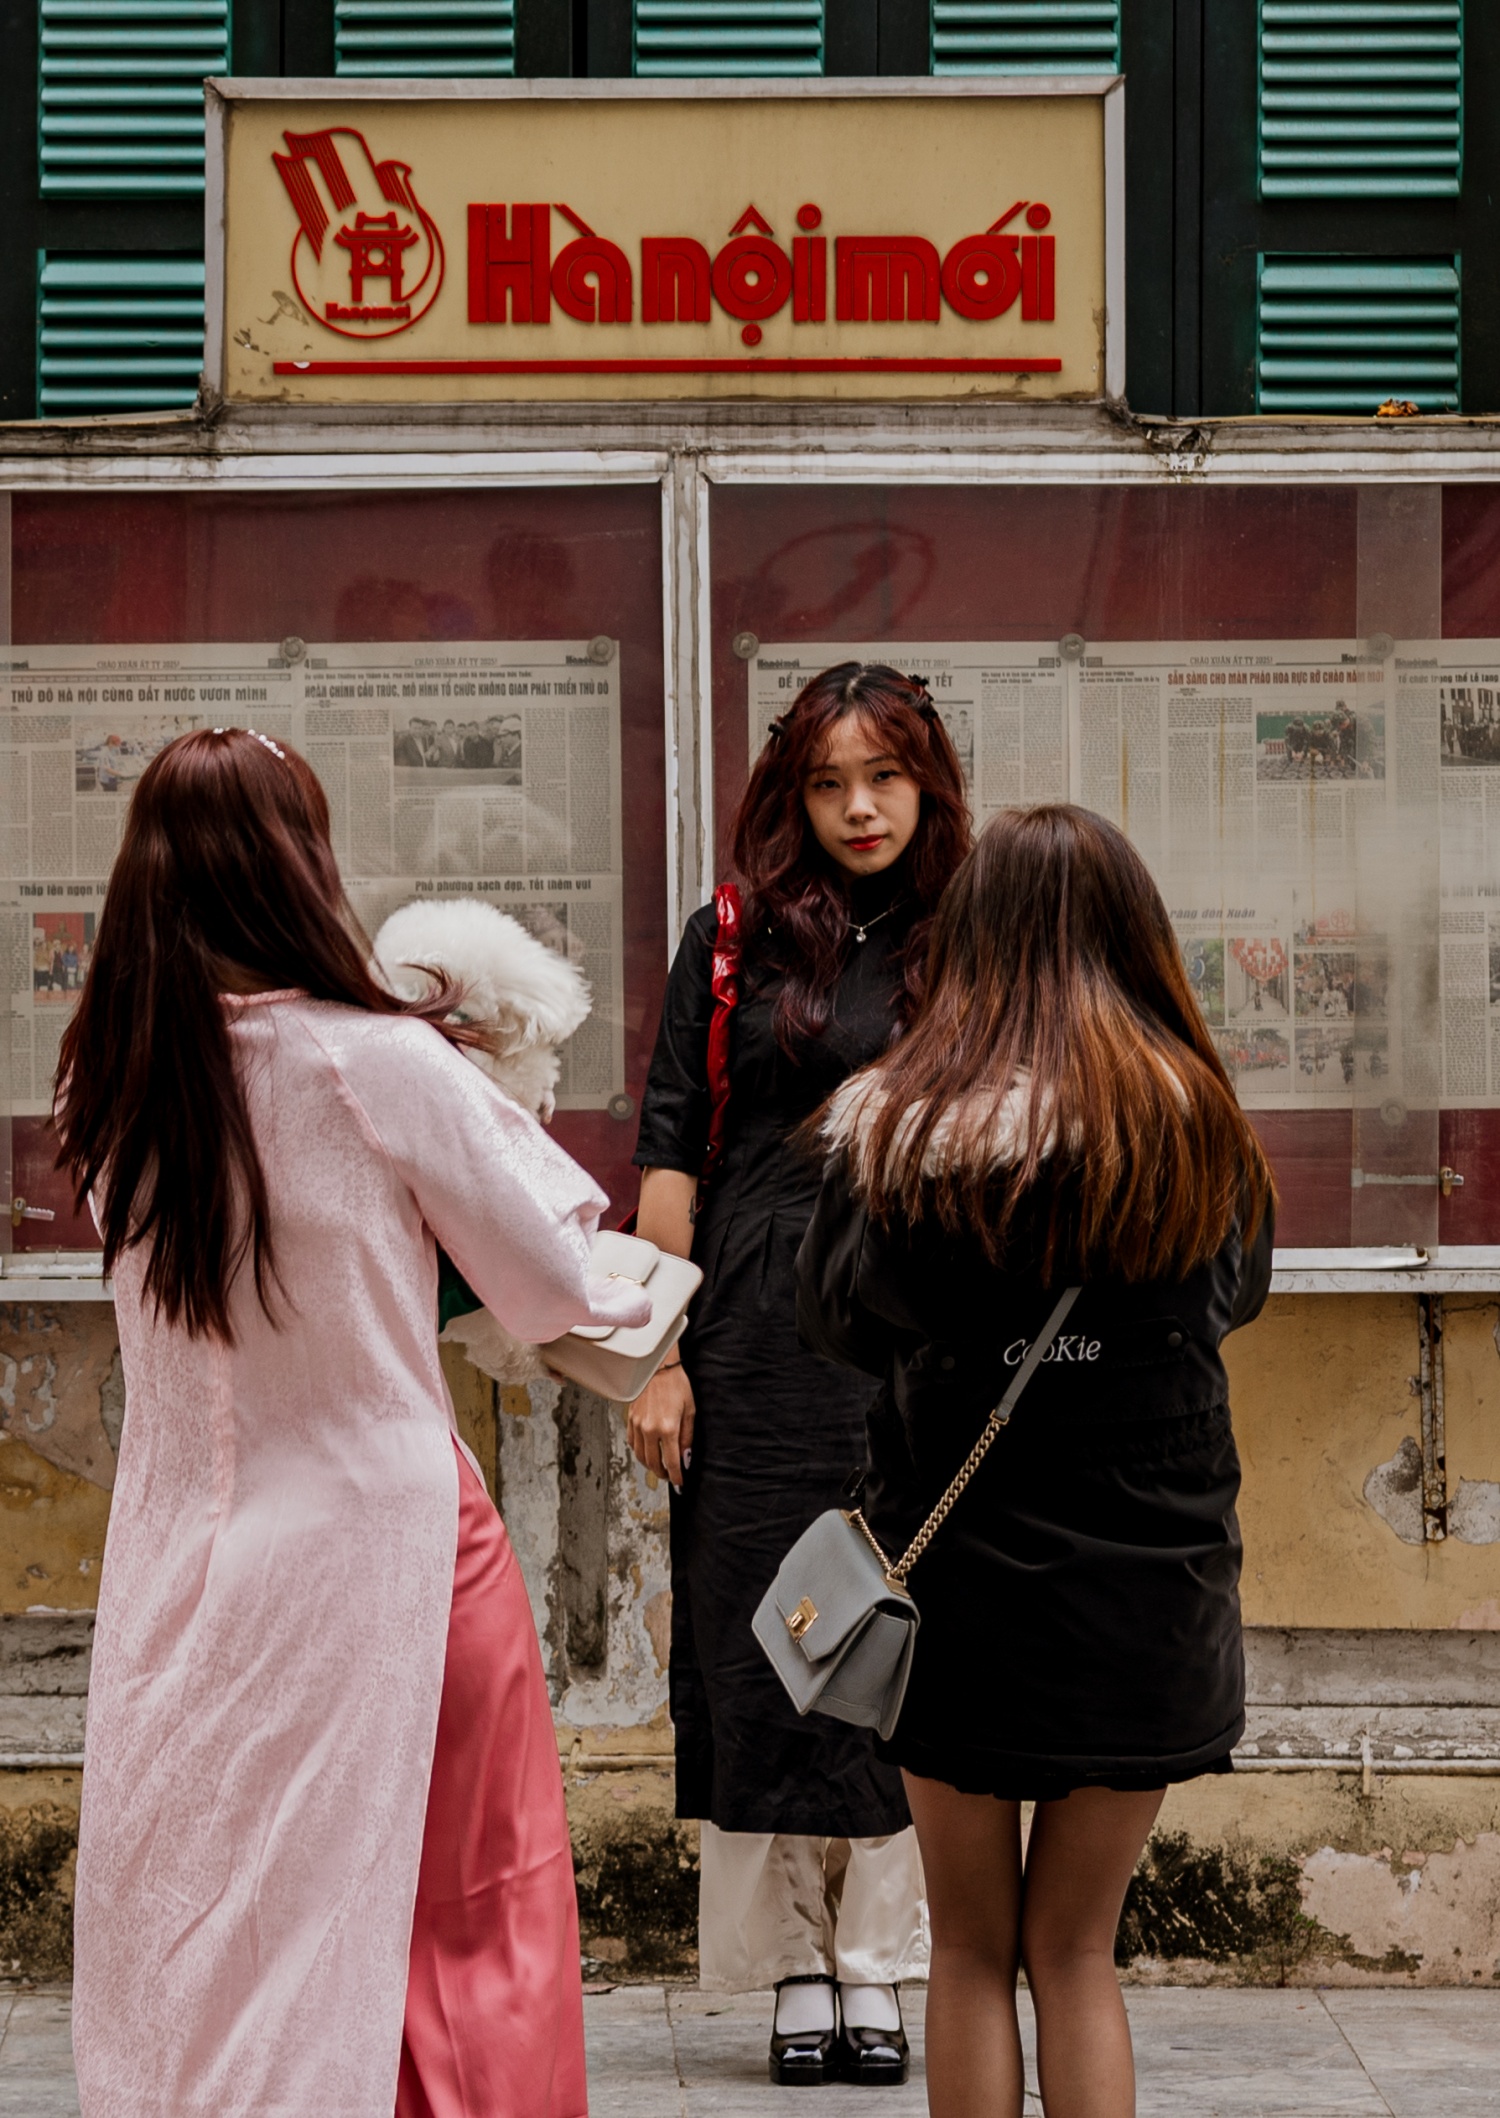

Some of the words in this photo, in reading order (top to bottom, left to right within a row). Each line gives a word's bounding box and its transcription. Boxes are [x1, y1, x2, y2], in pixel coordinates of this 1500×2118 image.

[468, 202, 1056, 346] Hànộimới
[118, 660, 138, 670] XUÂN
[435, 657, 456, 666] XUÂN
[1190, 656, 1210, 665] CHÀO
[1211, 655, 1231, 665] XUÂN
[935, 670, 954, 688] TẾT
[1186, 671, 1208, 685] SÀNG
[1210, 672, 1226, 685] CHO
[1228, 671, 1248, 685] MÀN
[1250, 670, 1271, 685] PHÁO
[1272, 672, 1290, 684] HOA
[1291, 671, 1308, 687] RỰC
[1323, 669, 1344, 684] CHÀO
[11, 686, 33, 702] THỦ
[38, 687, 54, 703] ĐÔ
[58, 687, 73, 702] HÀ
[78, 687, 98, 705] NỘI
[102, 687, 133, 702] CÙNG
[138, 684, 160, 702] ĐẤT
[164, 684, 196, 702] NƯỚC
[200, 687, 231, 701] VƯƠN
[235, 685, 267, 700] MÌNH
[357, 680, 374, 698] CẤU
[402, 681, 416, 697] MÔ
[418, 681, 439, 697] HÌNH
[441, 678, 452, 697] TỔ
[454, 681, 476, 697] CHỨC
[478, 680, 507, 696] KHÔNG
[508, 682, 528, 696] GIAN
[530, 680, 551, 696] PHÁT
[553, 677, 577, 696] TRIỂN
[579, 678, 595, 695] THỦ
[47, 884, 63, 896] lên
[67, 885, 93, 897] ngọn
[415, 879, 434, 892] Phố
[477, 881, 501, 894] sạch
[529, 878, 544, 891] Tết
[548, 879, 572, 891] thêm
[576, 880, 591, 890] vui
[1226, 907, 1256, 918] Xuân
